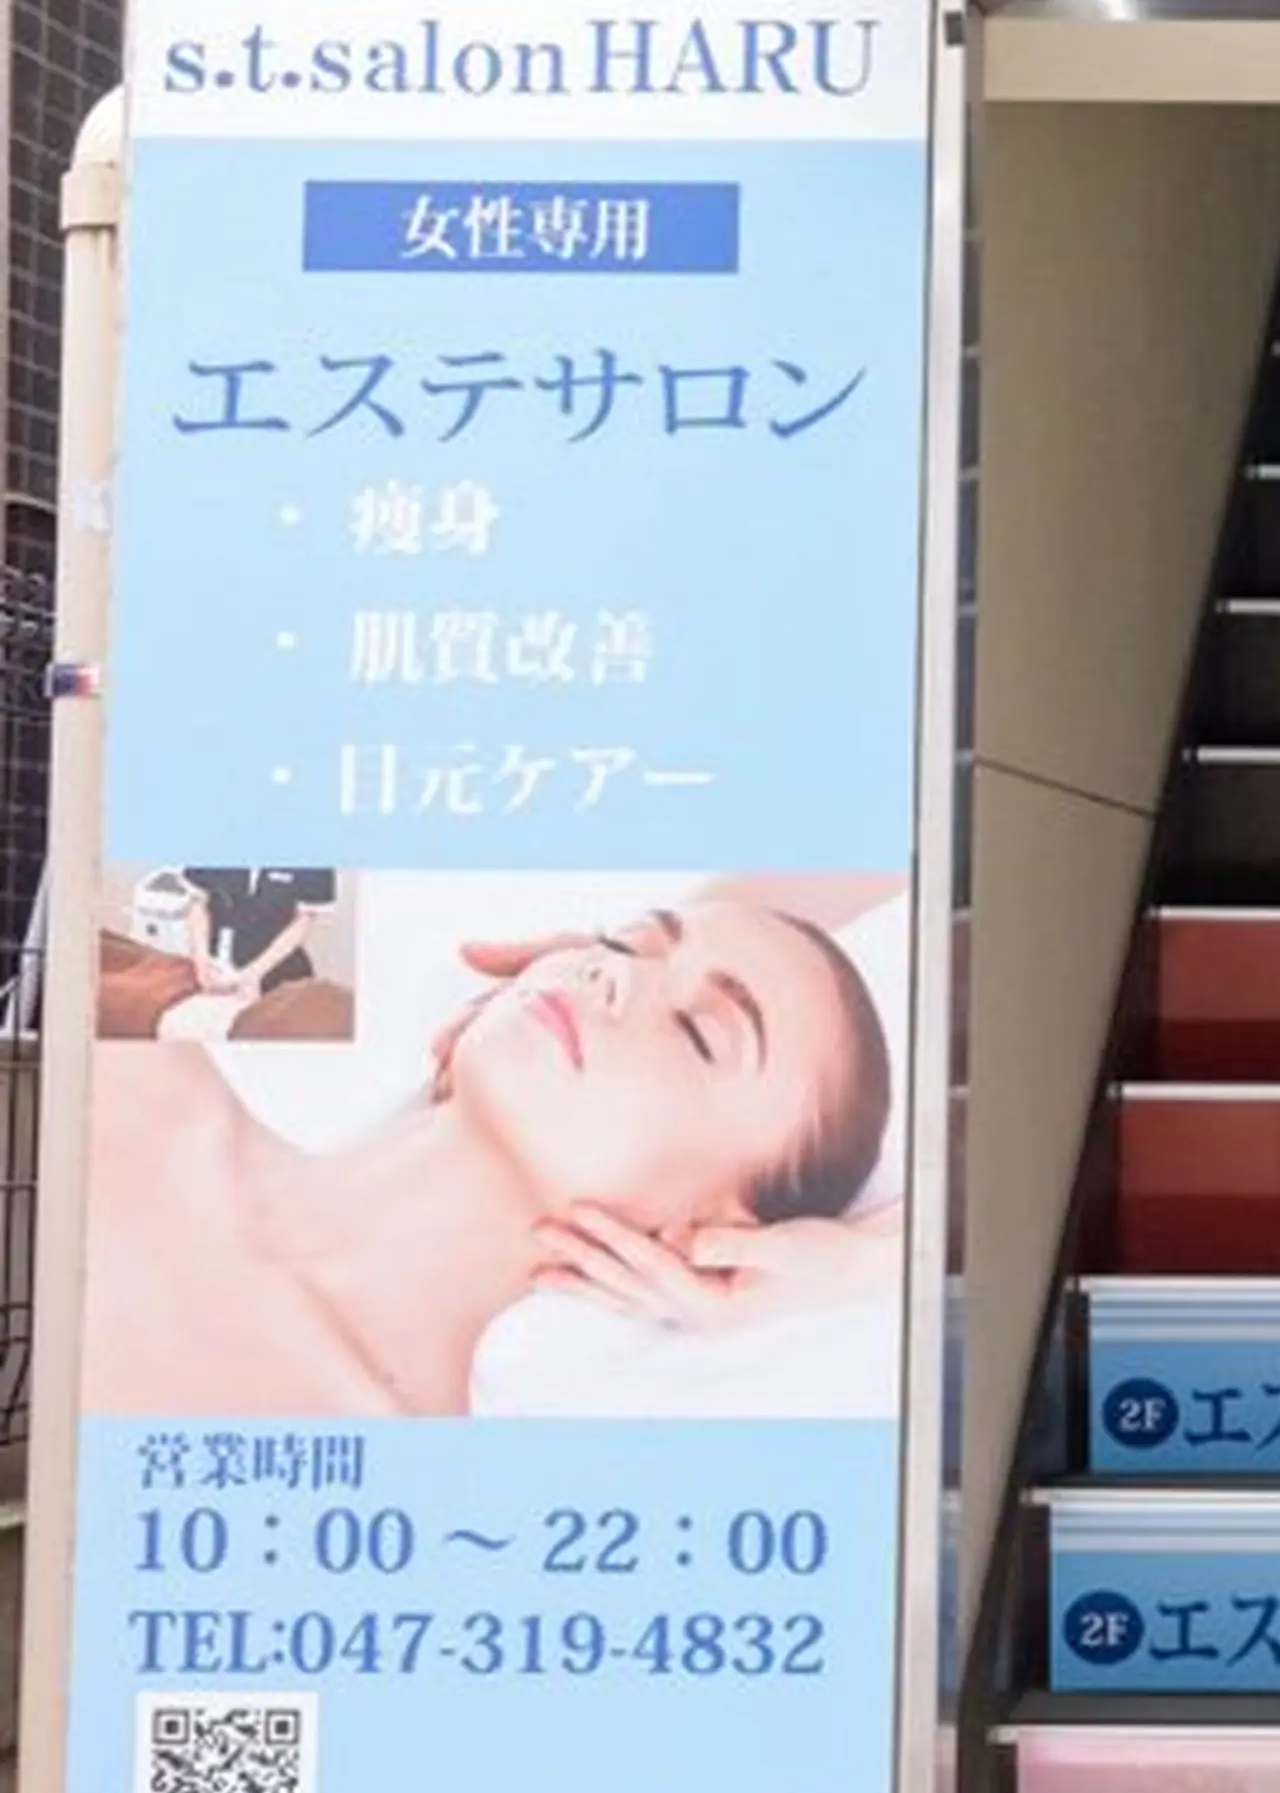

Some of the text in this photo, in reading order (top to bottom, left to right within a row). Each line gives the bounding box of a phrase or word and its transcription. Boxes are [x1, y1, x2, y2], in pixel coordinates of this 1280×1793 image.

[590, 20, 878, 96] HARU
[404, 196, 648, 259] 女性専用
[173, 348, 865, 442] エステサロン
[350, 607, 655, 685] 肌質改善
[1118, 1397, 1168, 1430] 2F
[139, 1434, 363, 1489] 営業時間
[129, 1611, 823, 1675] TEL:047-319-4832
[1080, 1613, 1130, 1646] 2F
